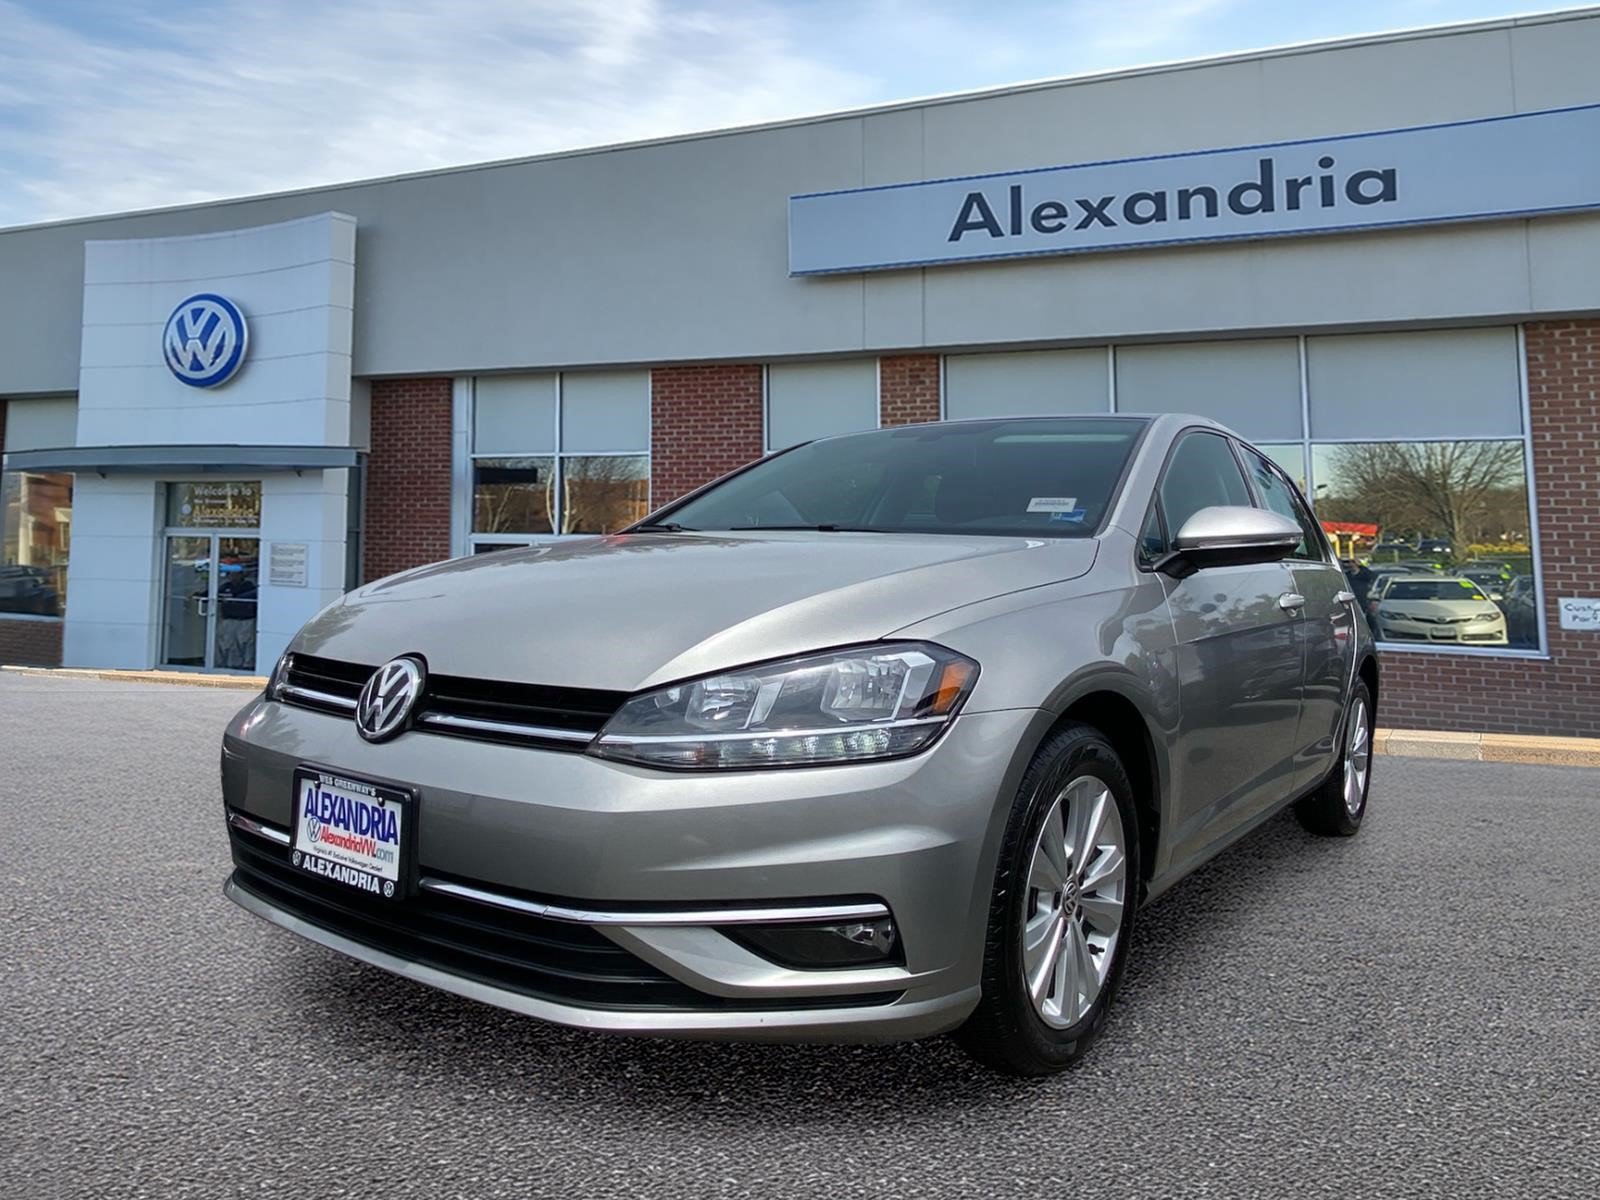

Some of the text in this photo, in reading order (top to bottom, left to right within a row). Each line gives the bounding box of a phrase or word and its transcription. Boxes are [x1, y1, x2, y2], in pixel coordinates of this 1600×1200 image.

[947, 155, 1399, 243] Alexandria
[304, 787, 398, 846] ALEXANDRIA
[320, 825, 393, 864] AlexandriaVW.com
[302, 854, 380, 894] ALEXANDRIA
